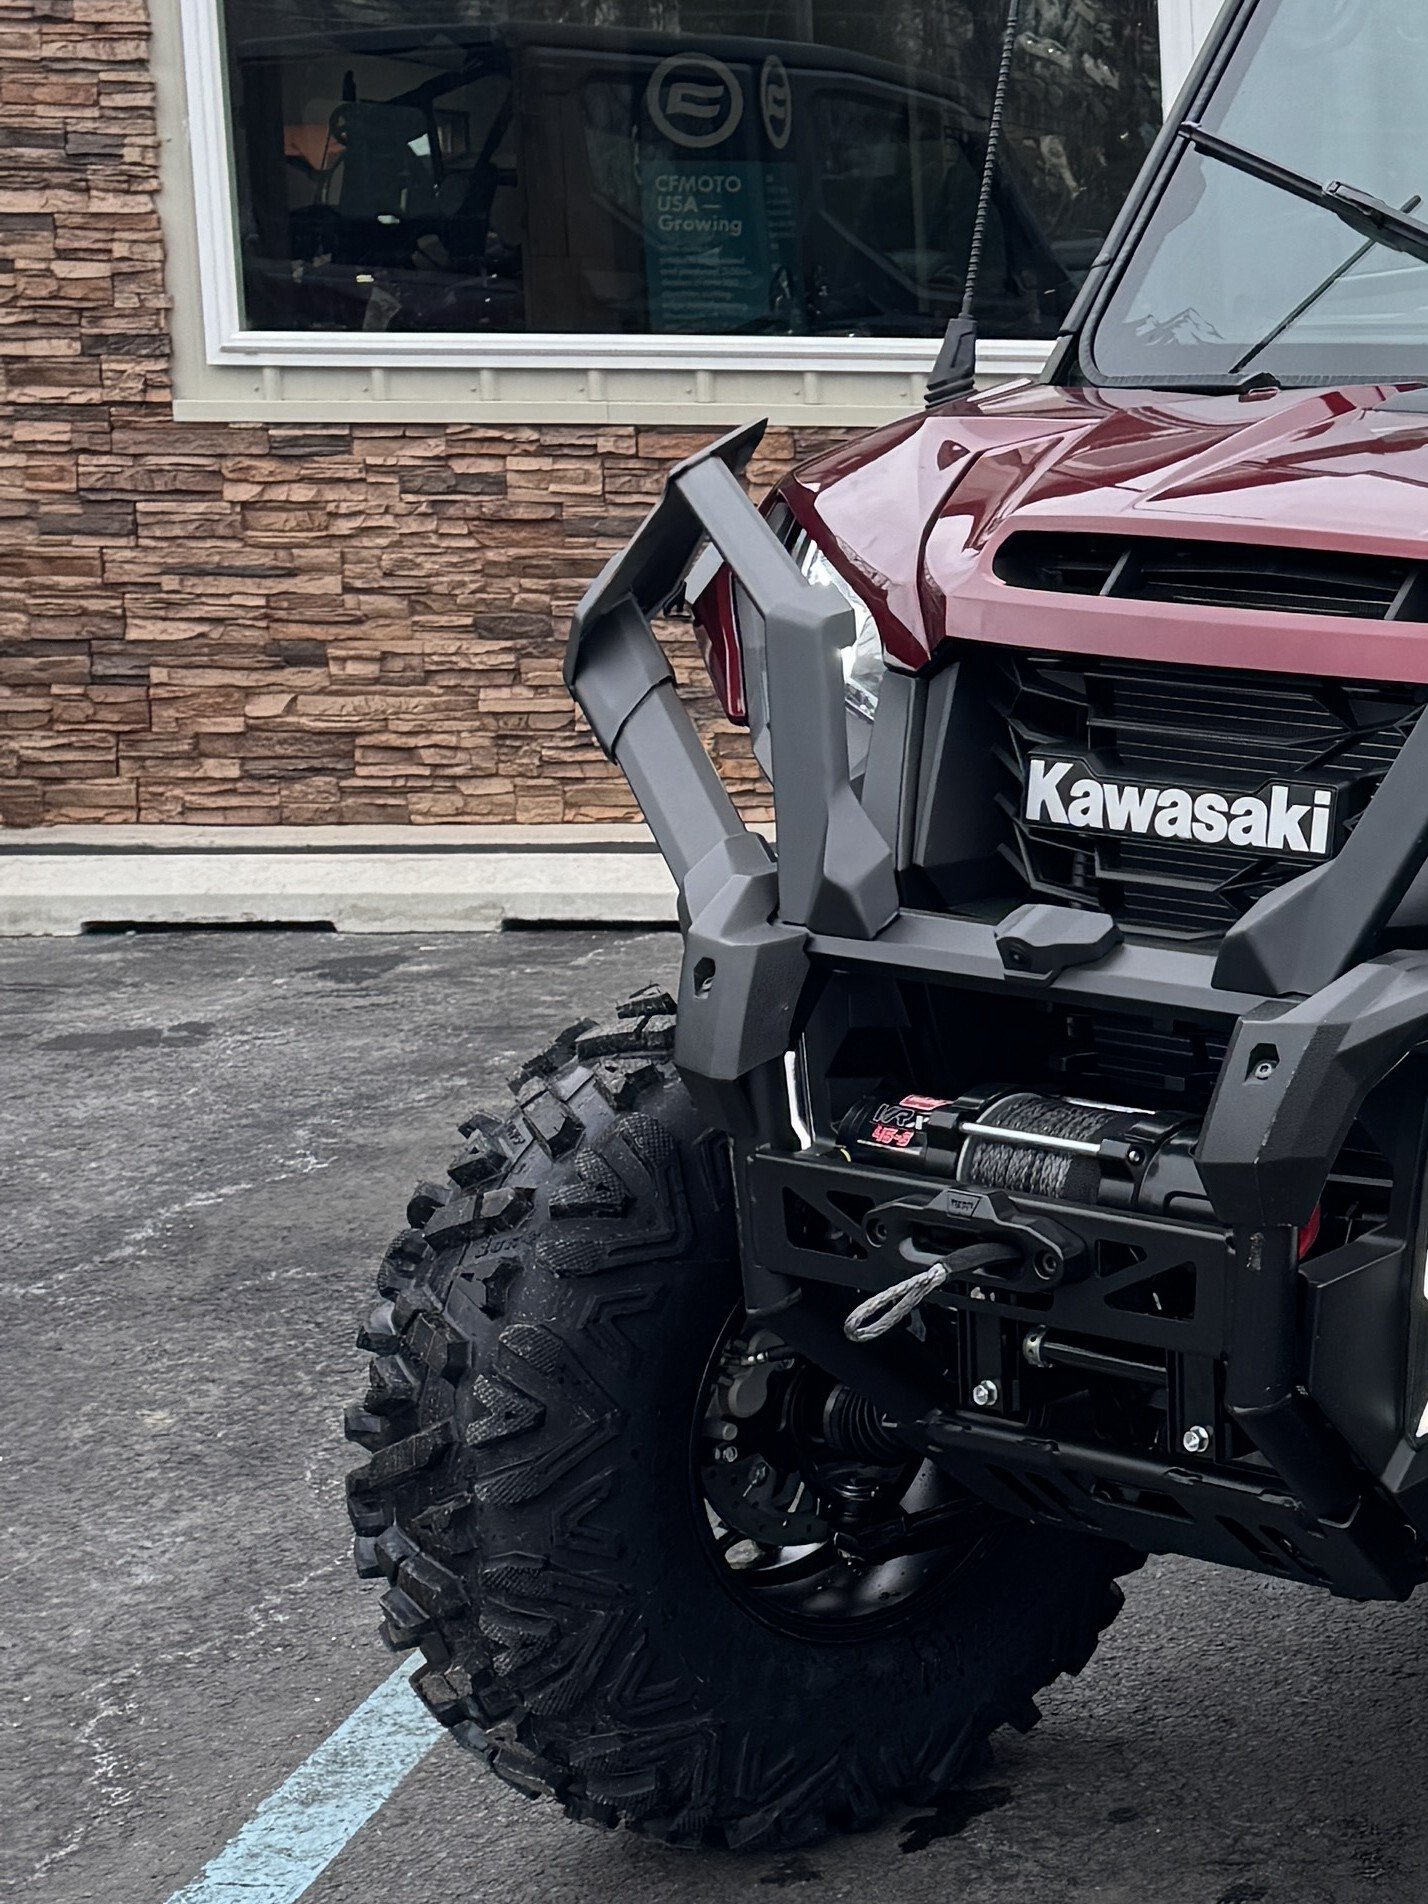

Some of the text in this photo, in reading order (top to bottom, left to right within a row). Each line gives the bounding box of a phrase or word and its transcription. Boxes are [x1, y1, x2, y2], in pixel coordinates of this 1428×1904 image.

[655, 174, 742, 193] CFMOTO
[657, 195, 699, 213] USA
[658, 215, 743, 237] Growing
[1025, 759, 1332, 854] Kawasaki
